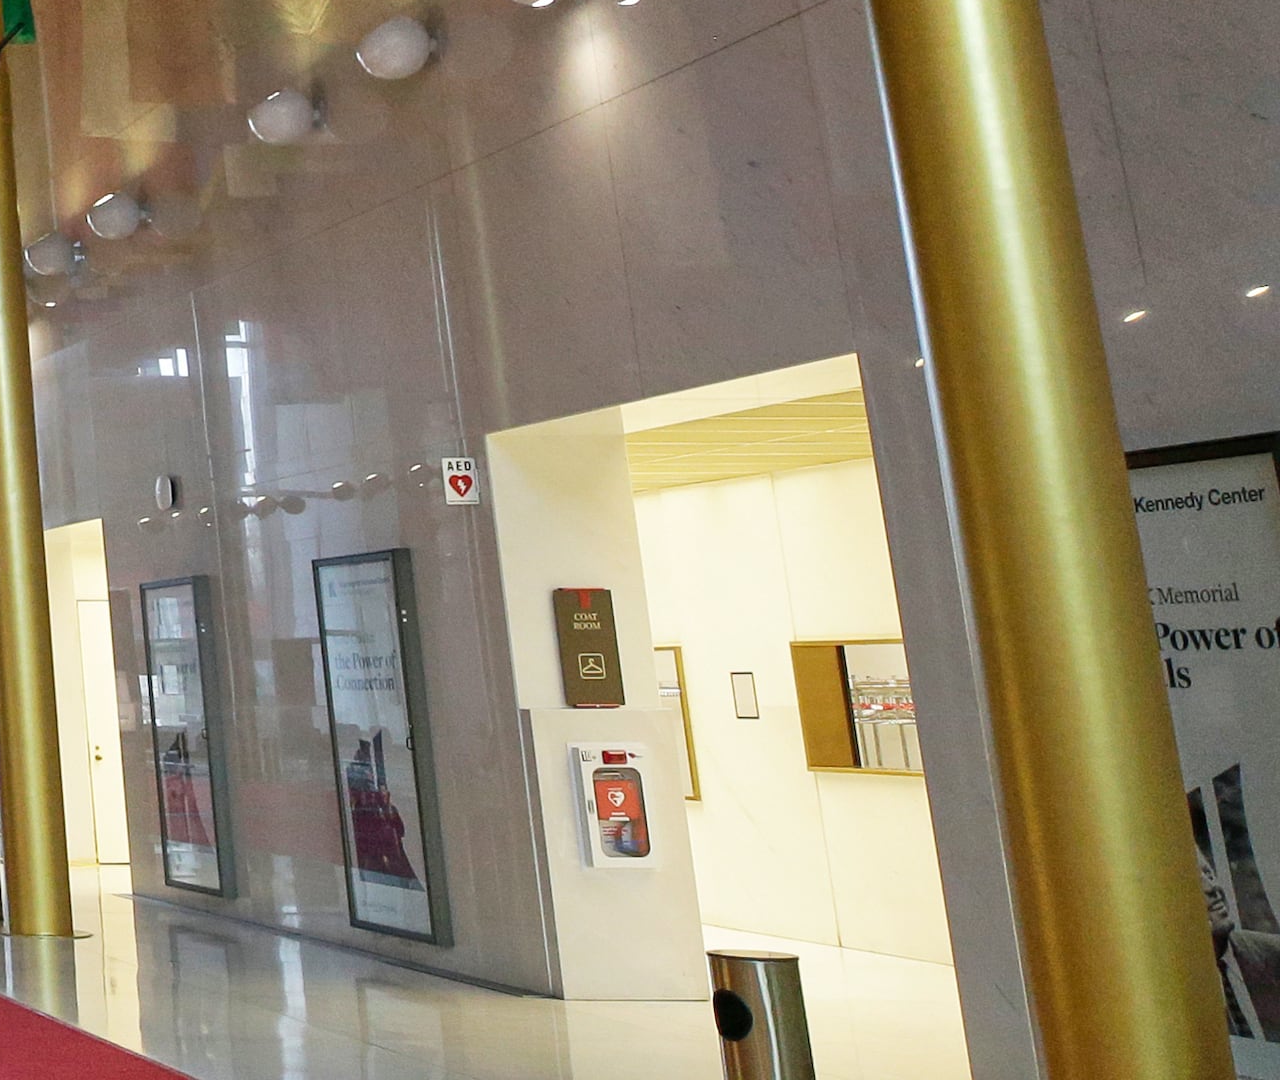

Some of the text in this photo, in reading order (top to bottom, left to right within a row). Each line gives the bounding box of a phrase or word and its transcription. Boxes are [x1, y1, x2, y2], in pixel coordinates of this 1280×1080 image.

[447, 461, 471, 471] AED
[1133, 486, 1266, 513] Kennedy Center
[1156, 582, 1240, 606] Memorial
[573, 613, 598, 621] COAT
[573, 622, 601, 630] ROOM
[1154, 622, 1247, 652] Power
[334, 649, 397, 670] the Power of
[336, 673, 396, 691] Connection
